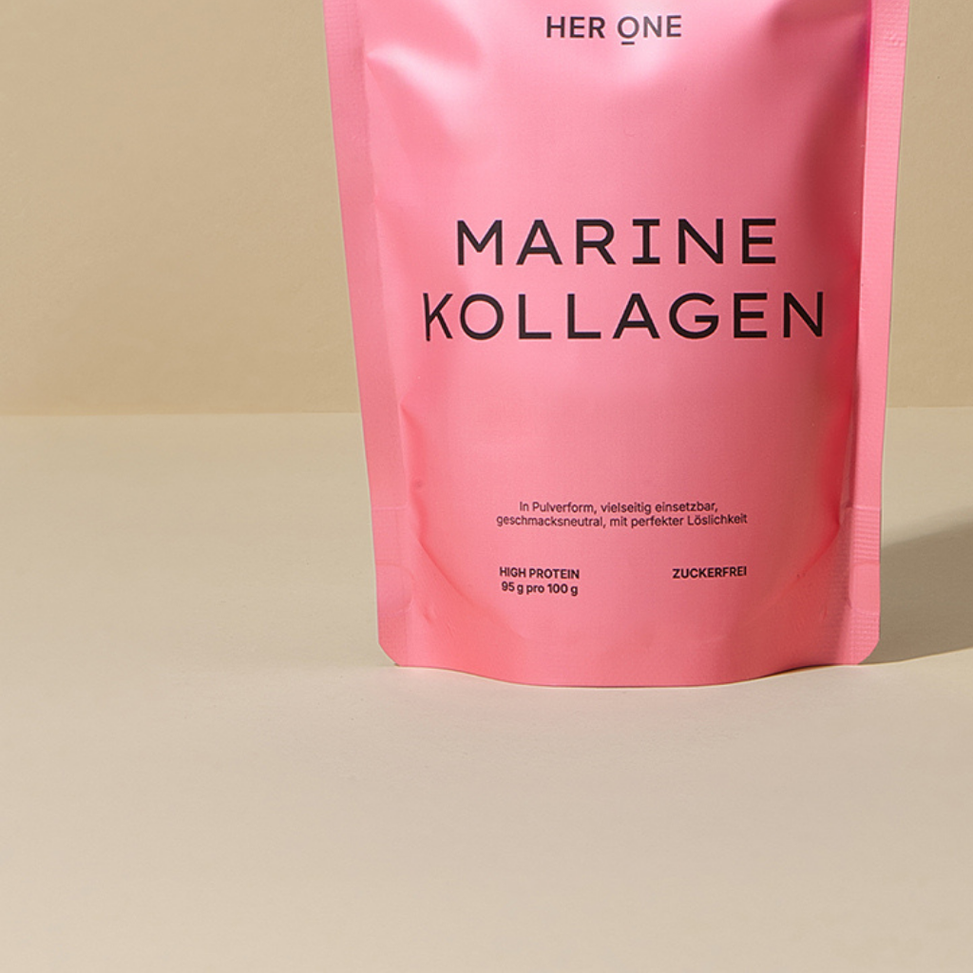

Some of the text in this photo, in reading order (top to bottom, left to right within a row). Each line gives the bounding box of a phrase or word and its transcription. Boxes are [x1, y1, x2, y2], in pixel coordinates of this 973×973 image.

[546, 14, 682, 45] HER ONE
[457, 217, 777, 265] MARINE
[422, 291, 825, 343] KOLLAGEN
[519, 501, 718, 515] In Pulverform, vielseitig einsetzbar,
[496, 513, 748, 529] geschmacksneutral, mit perfekter Löslichkeit
[499, 566, 580, 579] HIGH PROTEIN
[672, 566, 748, 579] ZUCKERFREI
[501, 581, 578, 597] 95 g pro 100 g
